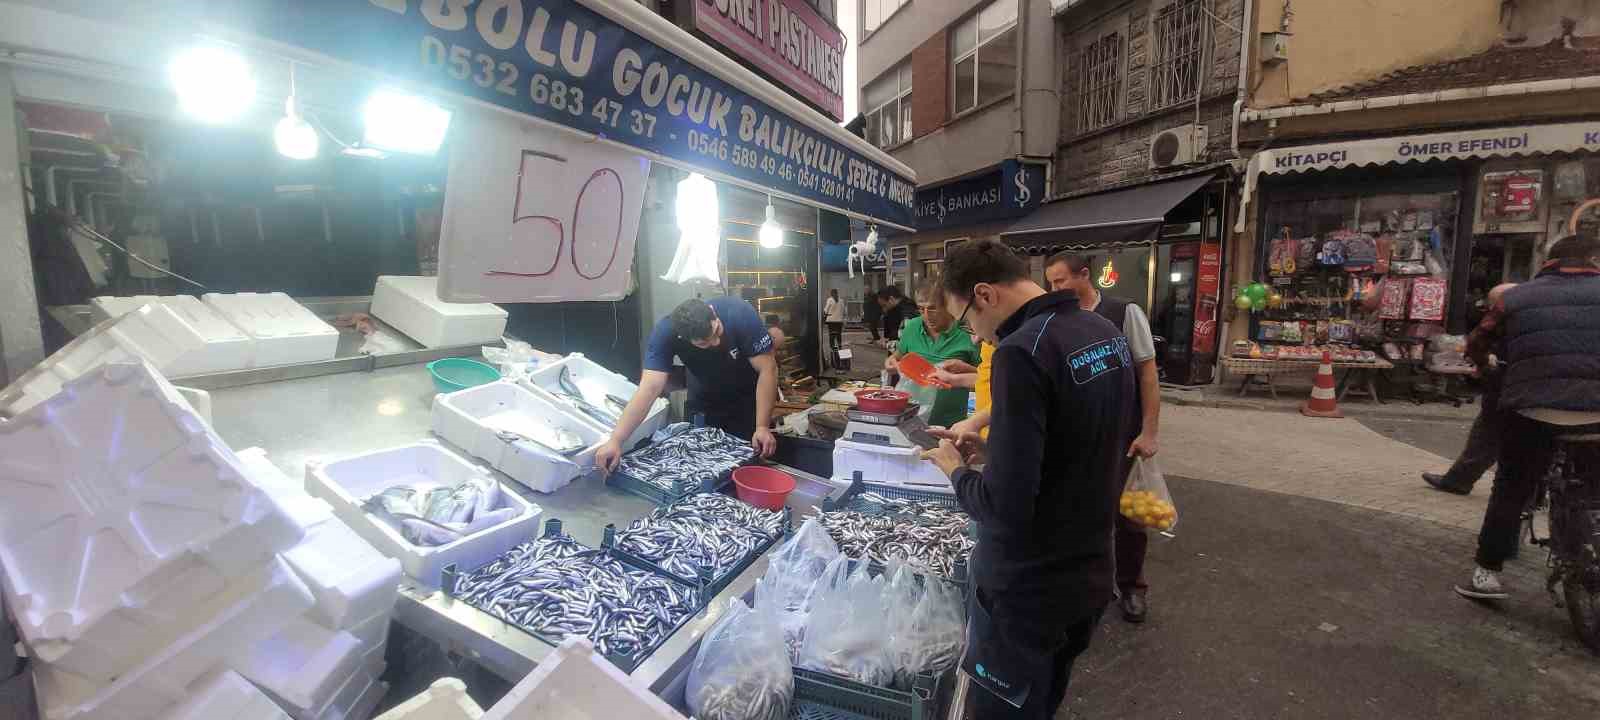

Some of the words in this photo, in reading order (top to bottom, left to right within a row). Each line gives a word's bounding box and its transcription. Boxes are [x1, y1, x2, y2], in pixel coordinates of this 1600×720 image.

[369, 0, 597, 78] BOLU
[420, 35, 519, 96] 0532
[530, 73, 584, 116] 683
[591, 97, 623, 128] 47
[630, 108, 657, 138] 37
[687, 129, 728, 161] 0546
[731, 143, 758, 169] 589
[759, 154, 776, 175] 49
[1275, 149, 1348, 169] KİTAPÇI
[1397, 141, 1453, 157] ÖMER
[1457, 132, 1529, 154] EFENDİ
[483, 149, 624, 281] 50
[948, 190, 1001, 212] BANKASI
